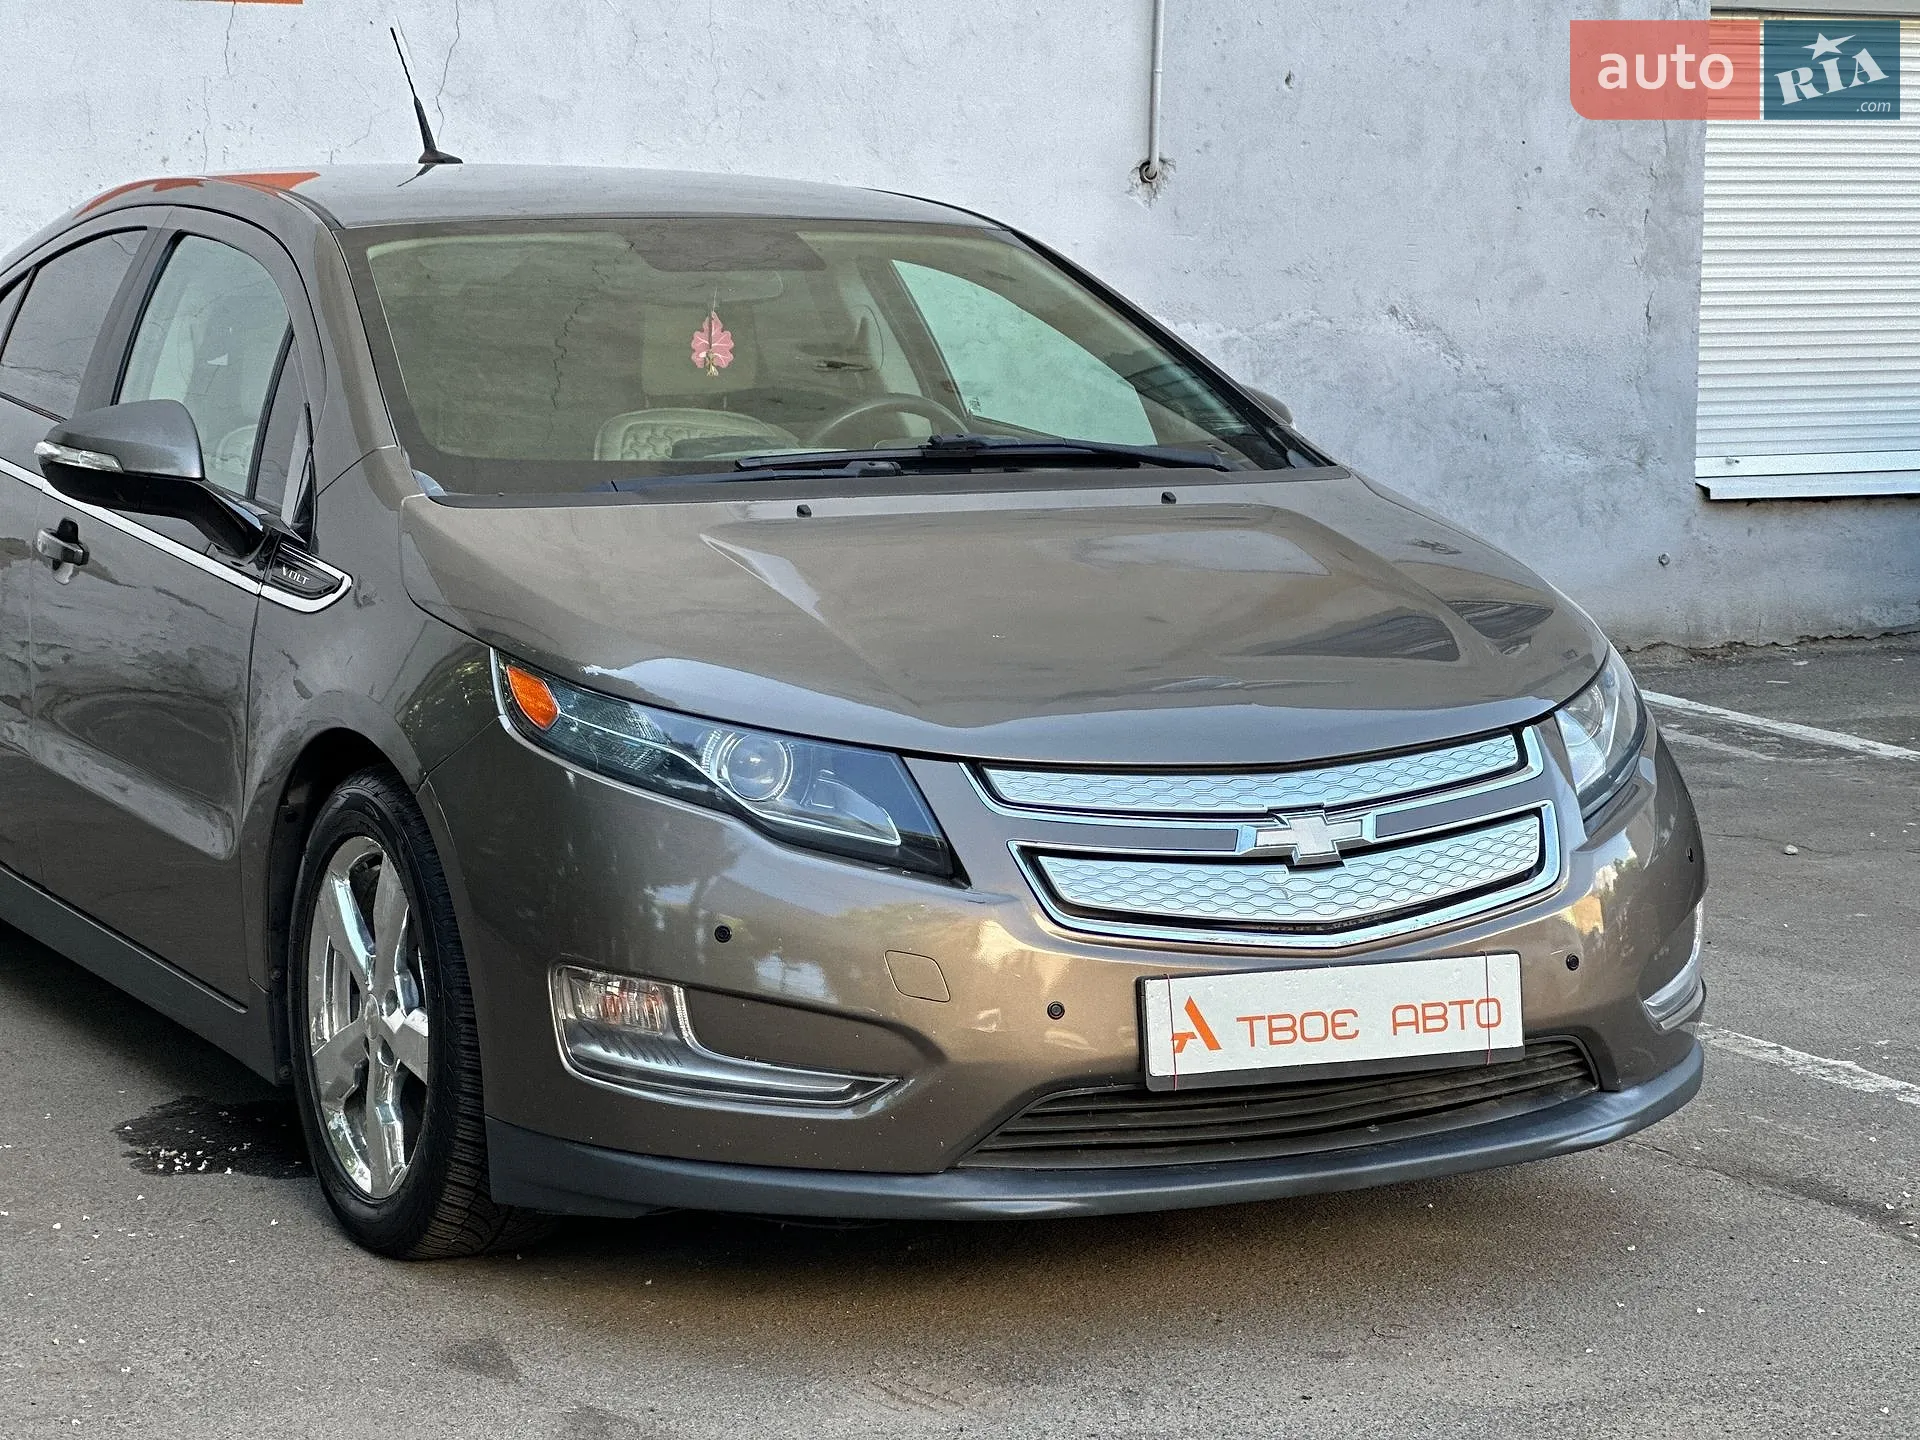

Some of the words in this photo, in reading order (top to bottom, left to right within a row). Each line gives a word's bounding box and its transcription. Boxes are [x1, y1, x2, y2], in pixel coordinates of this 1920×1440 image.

[281, 564, 310, 585] VOLT
[1236, 1009, 1360, 1047] ТВОЄ
[1391, 997, 1502, 1036] АВТО
